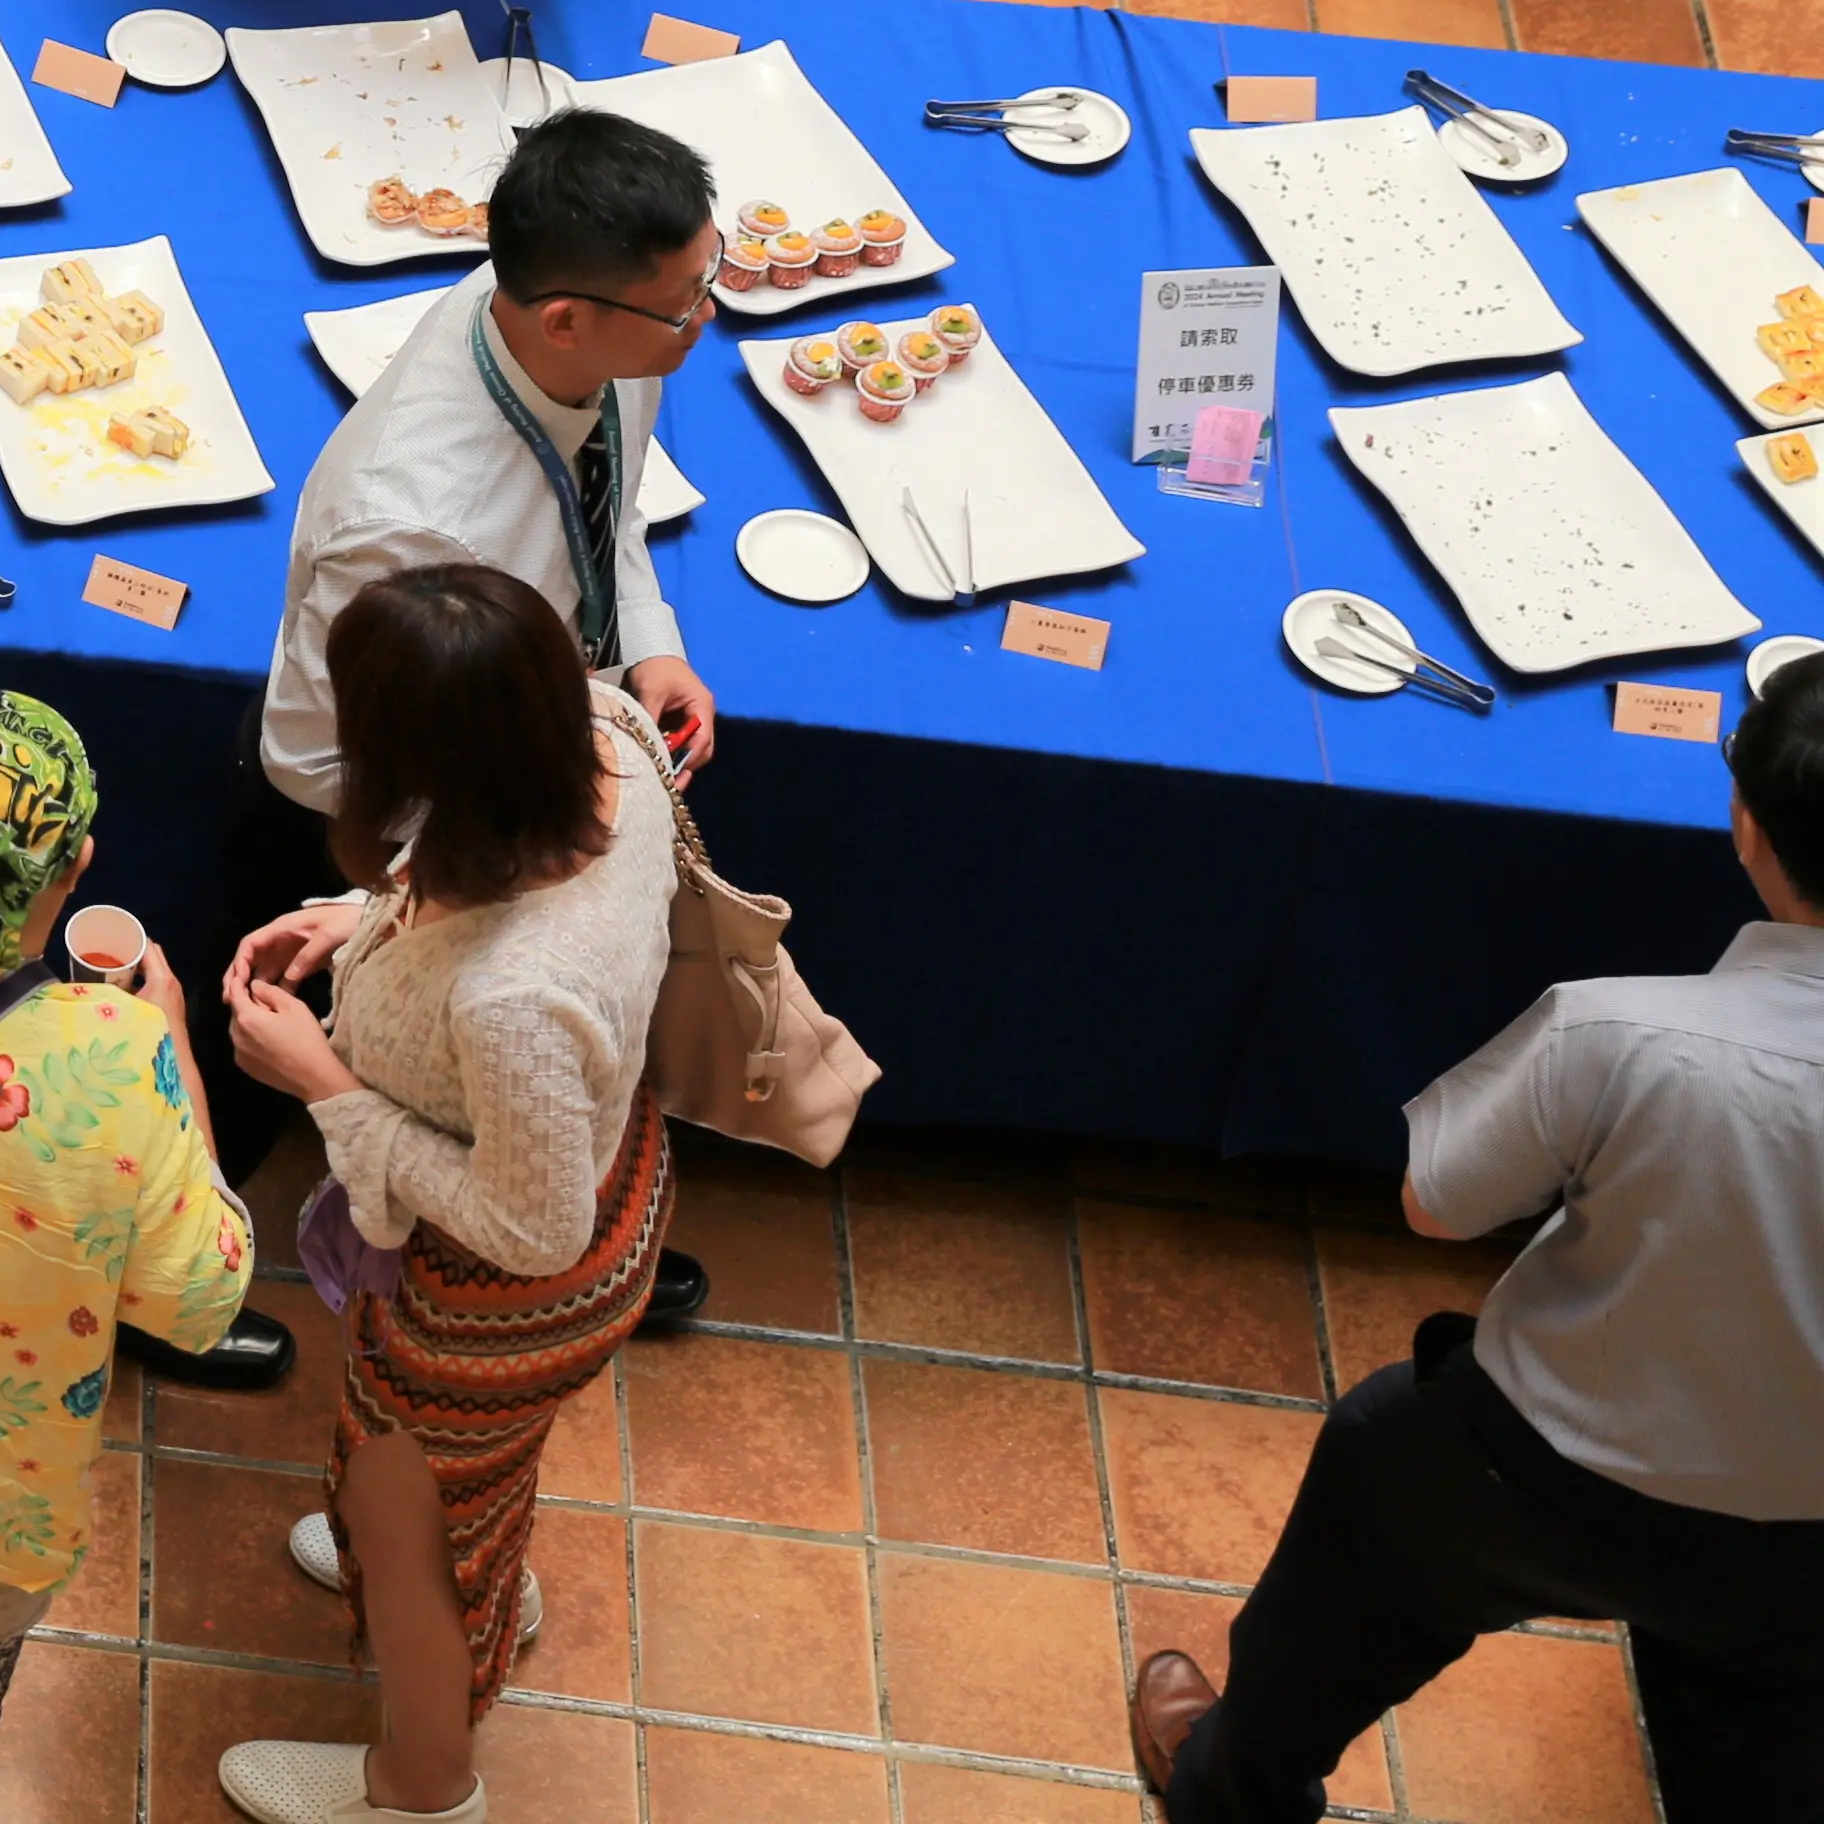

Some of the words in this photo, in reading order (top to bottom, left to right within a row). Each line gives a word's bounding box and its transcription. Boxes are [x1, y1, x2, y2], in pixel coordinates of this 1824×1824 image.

[1180, 327, 1238, 348] 請索取
[1158, 373, 1256, 396] 停車優惠券
